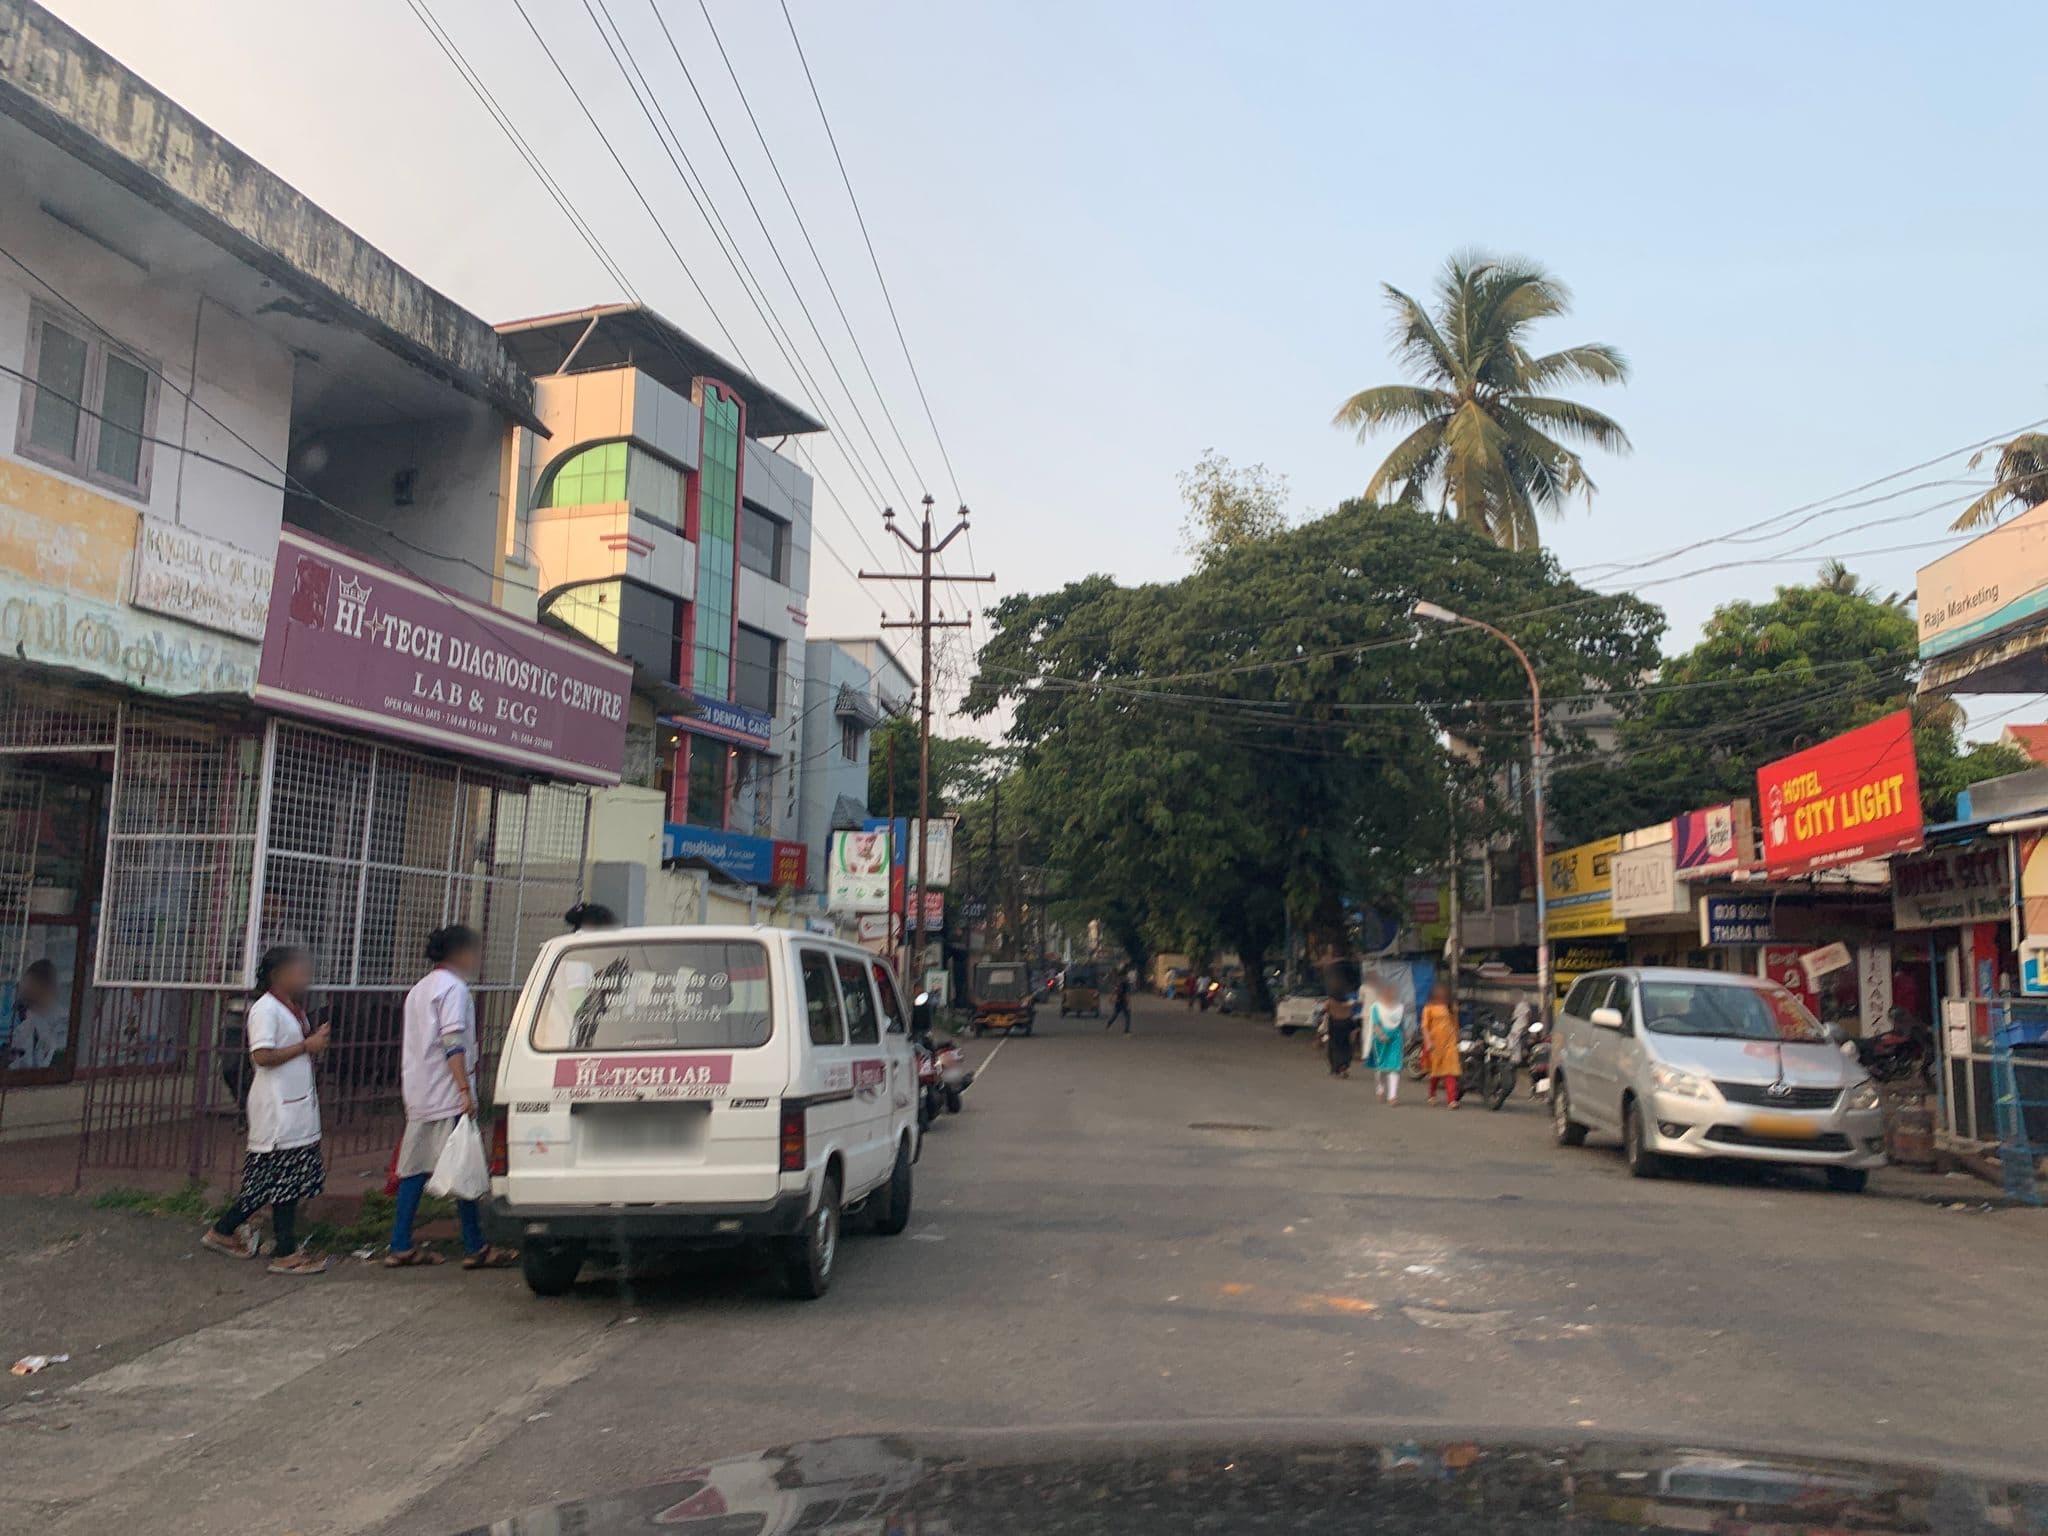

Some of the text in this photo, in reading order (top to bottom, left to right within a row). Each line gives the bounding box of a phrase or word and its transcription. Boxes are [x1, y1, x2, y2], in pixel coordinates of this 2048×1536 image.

[1924, 584, 1999, 629] Raja Marketing
[382, 613, 443, 664] TECH
[447, 637, 558, 699] DIAGNOSTIC
[561, 676, 622, 721] CENTRE
[384, 696, 401, 711] OPEN
[403, 701, 412, 714] ON
[412, 705, 424, 718] ALL
[425, 708, 441, 722] DAYS
[412, 671, 538, 728] LAB & ECG
[713, 708, 746, 730] DENTAL
[749, 719, 770, 737] CARE
[1782, 770, 1822, 805] HOTEL
[1793, 773, 1904, 841] CITY LIGHT
[708, 972, 728, 990] @
[614, 1066, 665, 1085] TECH
[667, 1065, 711, 1084] LAB
